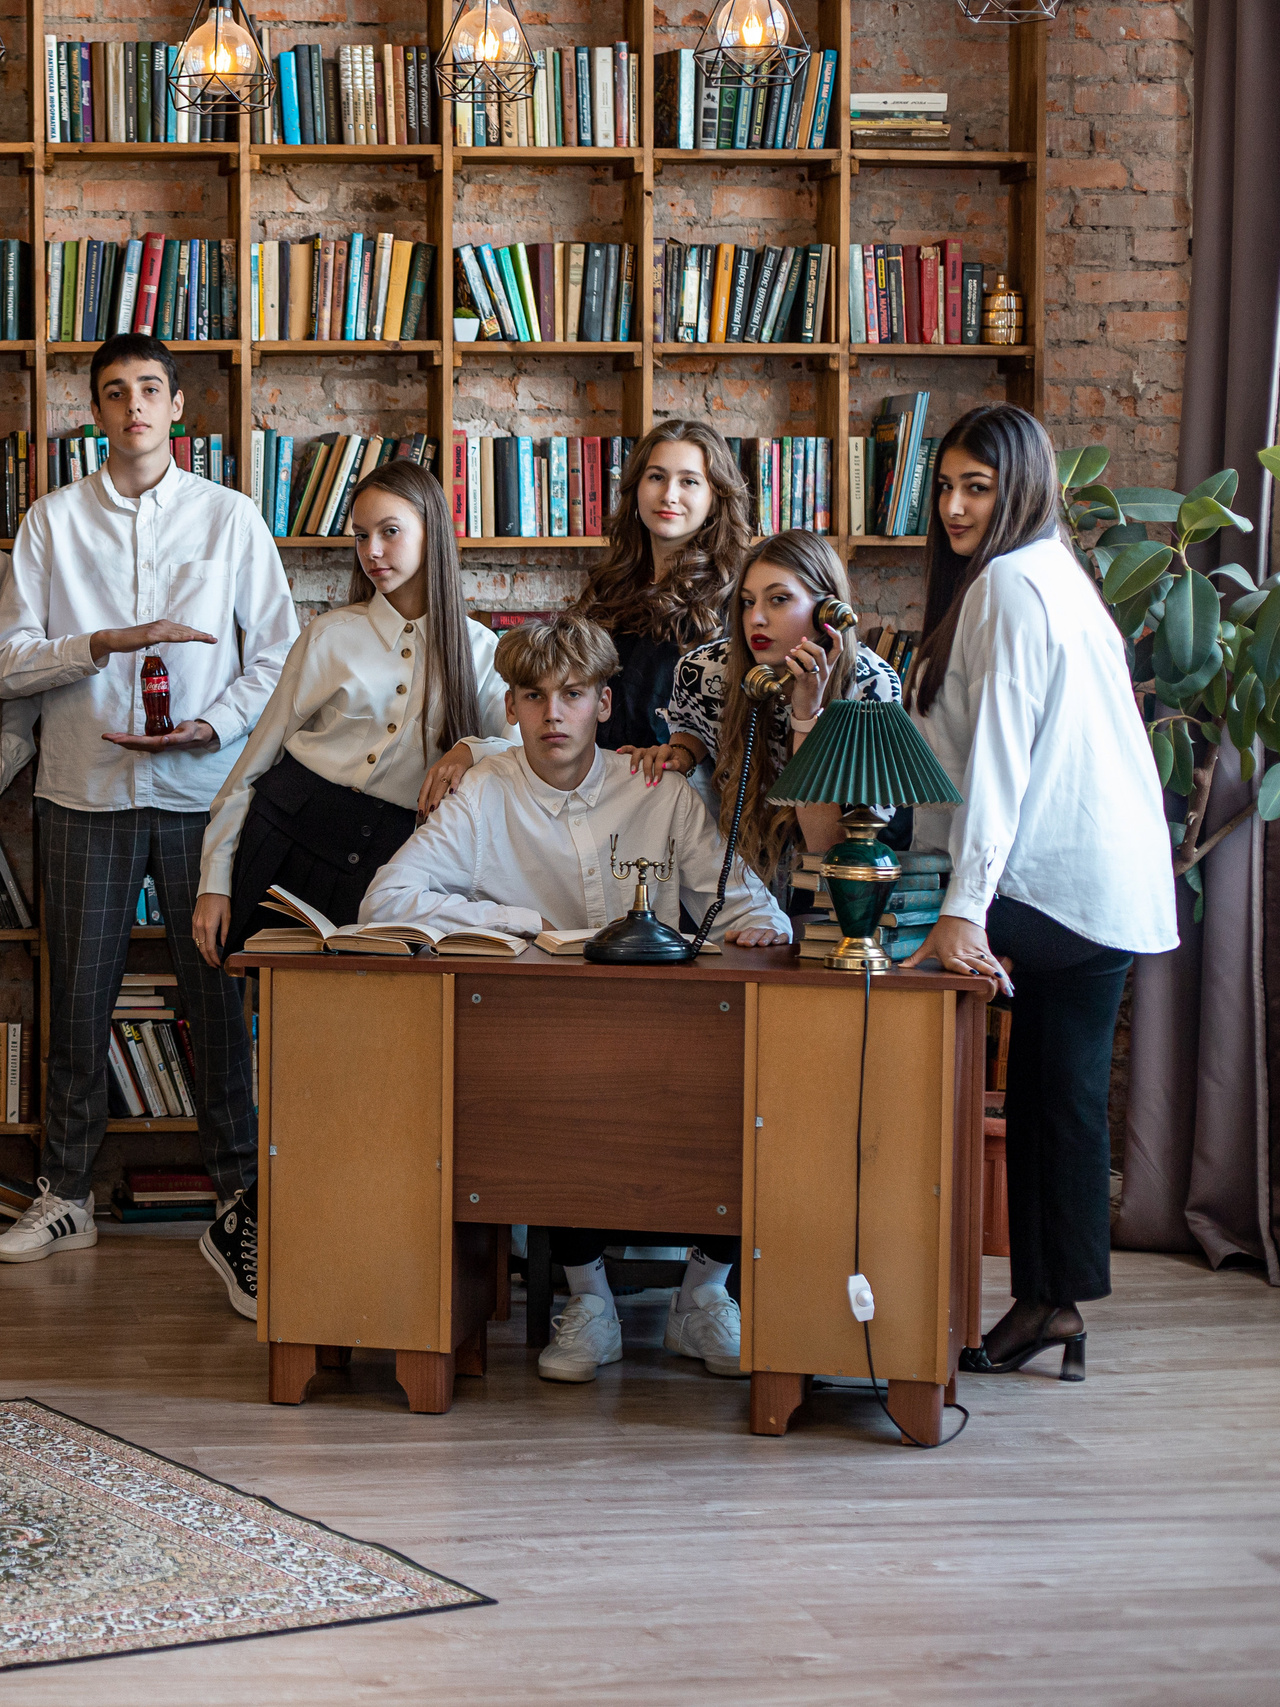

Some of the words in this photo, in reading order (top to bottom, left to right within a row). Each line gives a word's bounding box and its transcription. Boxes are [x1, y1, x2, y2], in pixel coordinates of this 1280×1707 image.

[47, 49, 55, 93] ПРАКТИЧЕСКАЯ
[49, 96, 57, 139] ИНФОРМАТИКА
[737, 268, 747, 287] ЗОВ
[752, 287, 767, 325] ВЕЧНЫЙ
[760, 269, 771, 287] ЗОВ
[733, 287, 745, 324] ВЕЧНЫЙ
[879, 297, 888, 339] МАРИНИНА
[731, 327, 739, 336] 2
